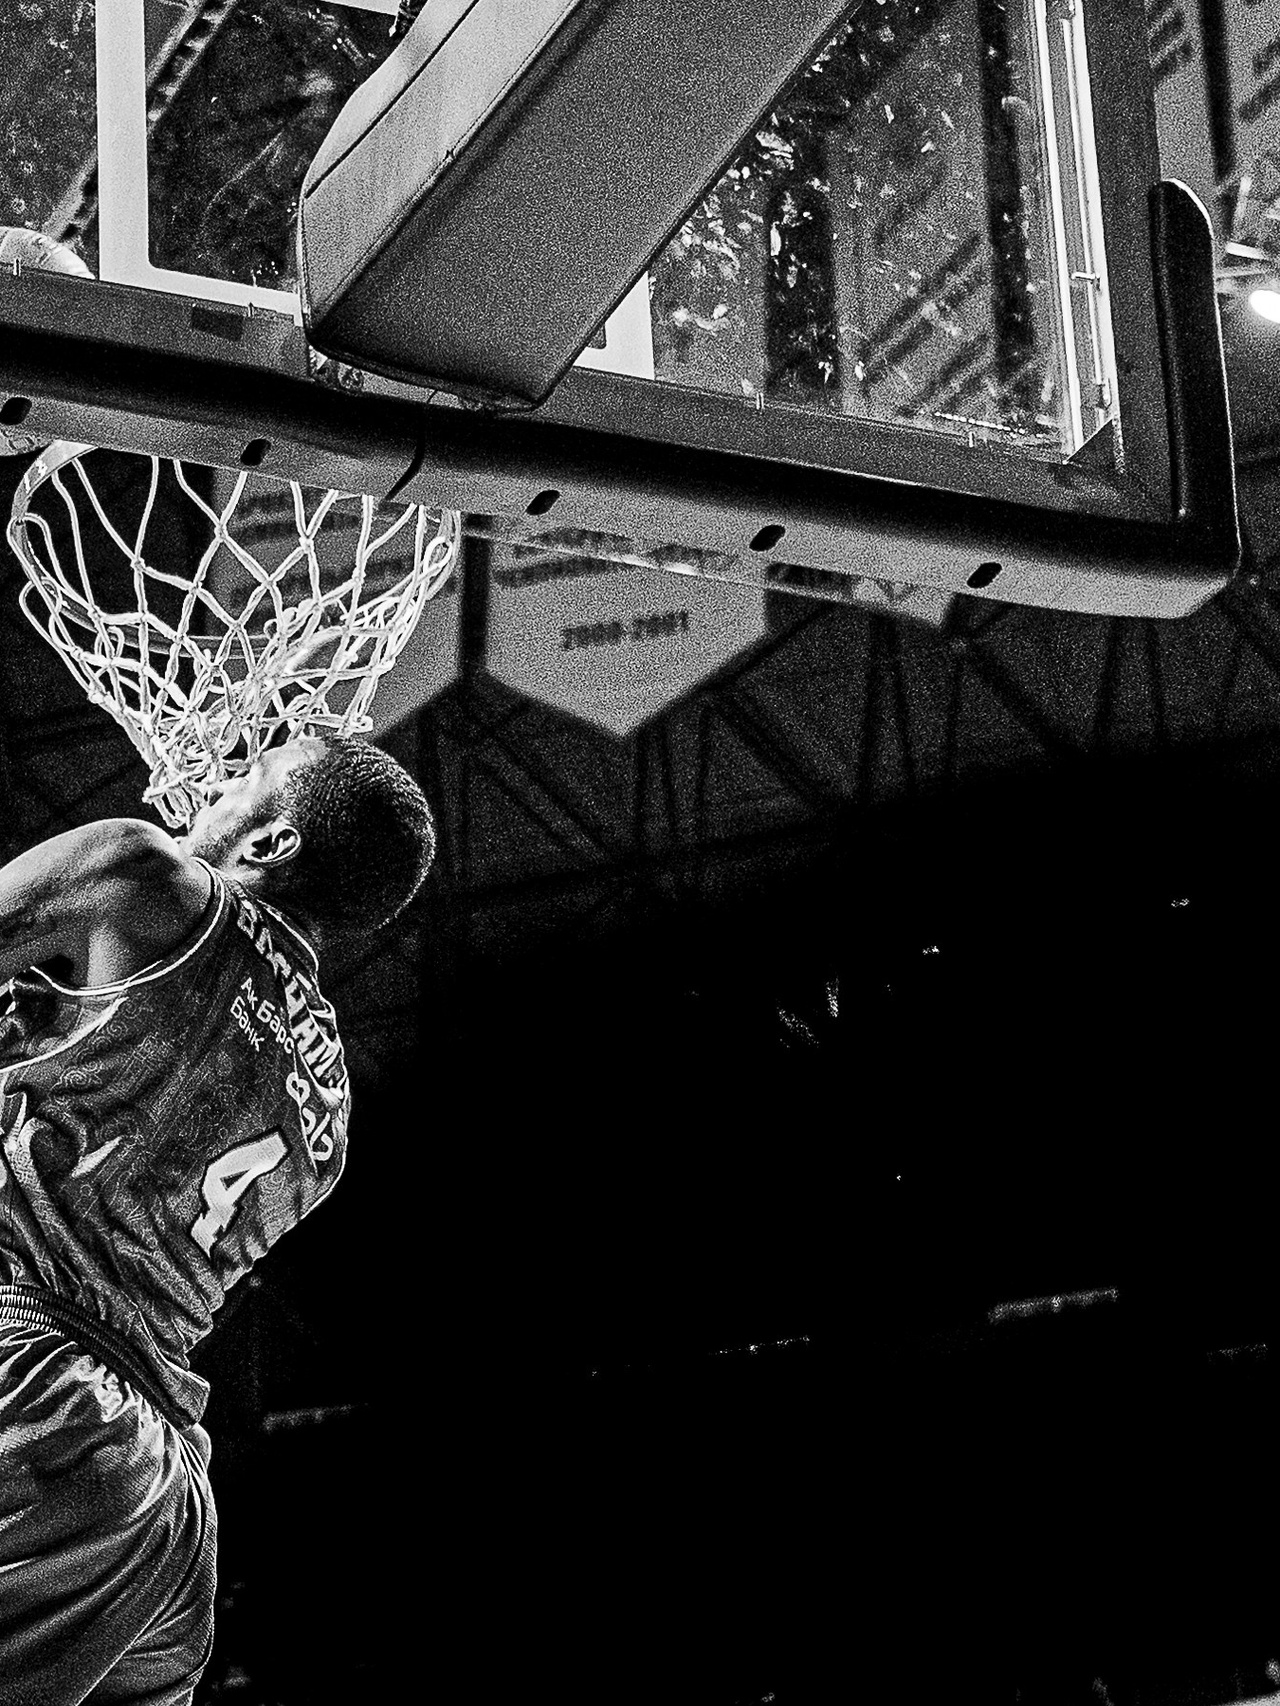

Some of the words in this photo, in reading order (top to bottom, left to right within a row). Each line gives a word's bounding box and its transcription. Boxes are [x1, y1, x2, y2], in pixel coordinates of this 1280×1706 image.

[230, 996, 265, 1052] Банк
[241, 977, 258, 1010] Ак
[257, 1000, 294, 1054] Барс
[190, 1131, 287, 1258] 4
